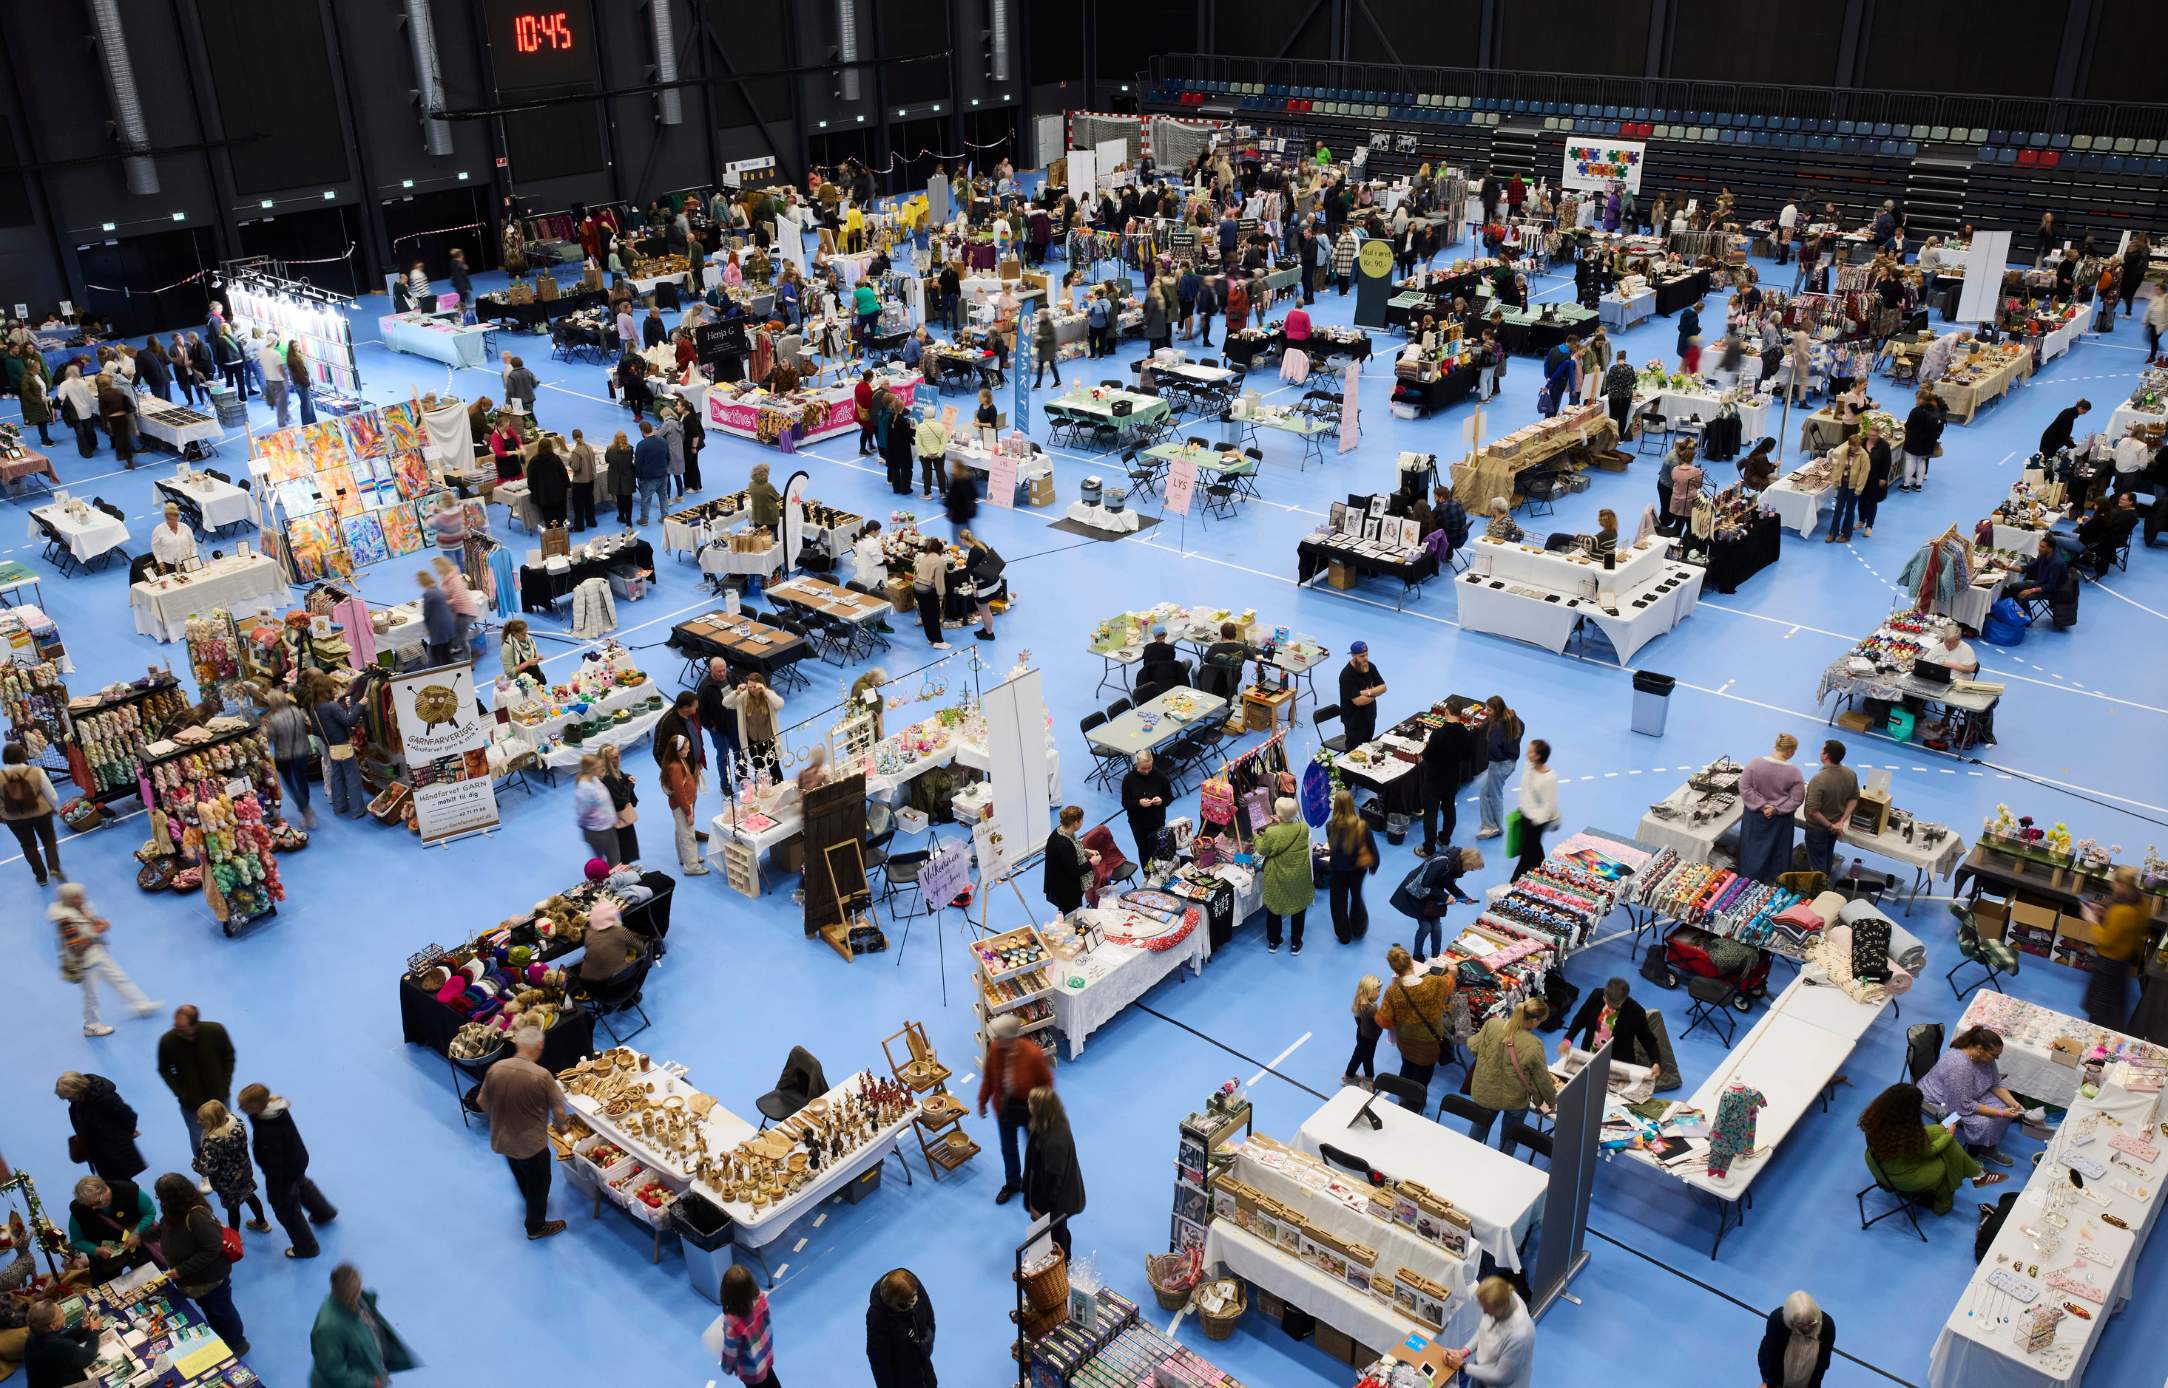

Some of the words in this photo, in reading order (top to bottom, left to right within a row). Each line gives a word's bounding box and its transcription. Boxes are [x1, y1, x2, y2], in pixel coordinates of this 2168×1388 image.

[515, 12, 572, 52] 10:45
[711, 401, 758, 429] Dorthe1
[1173, 478, 1188, 490] LYS
[408, 720, 476, 746] GARNFARVERIGET
[419, 786, 460, 802] Håndfarvet
[462, 780, 487, 792] GARN
[469, 791, 479, 799] dig
